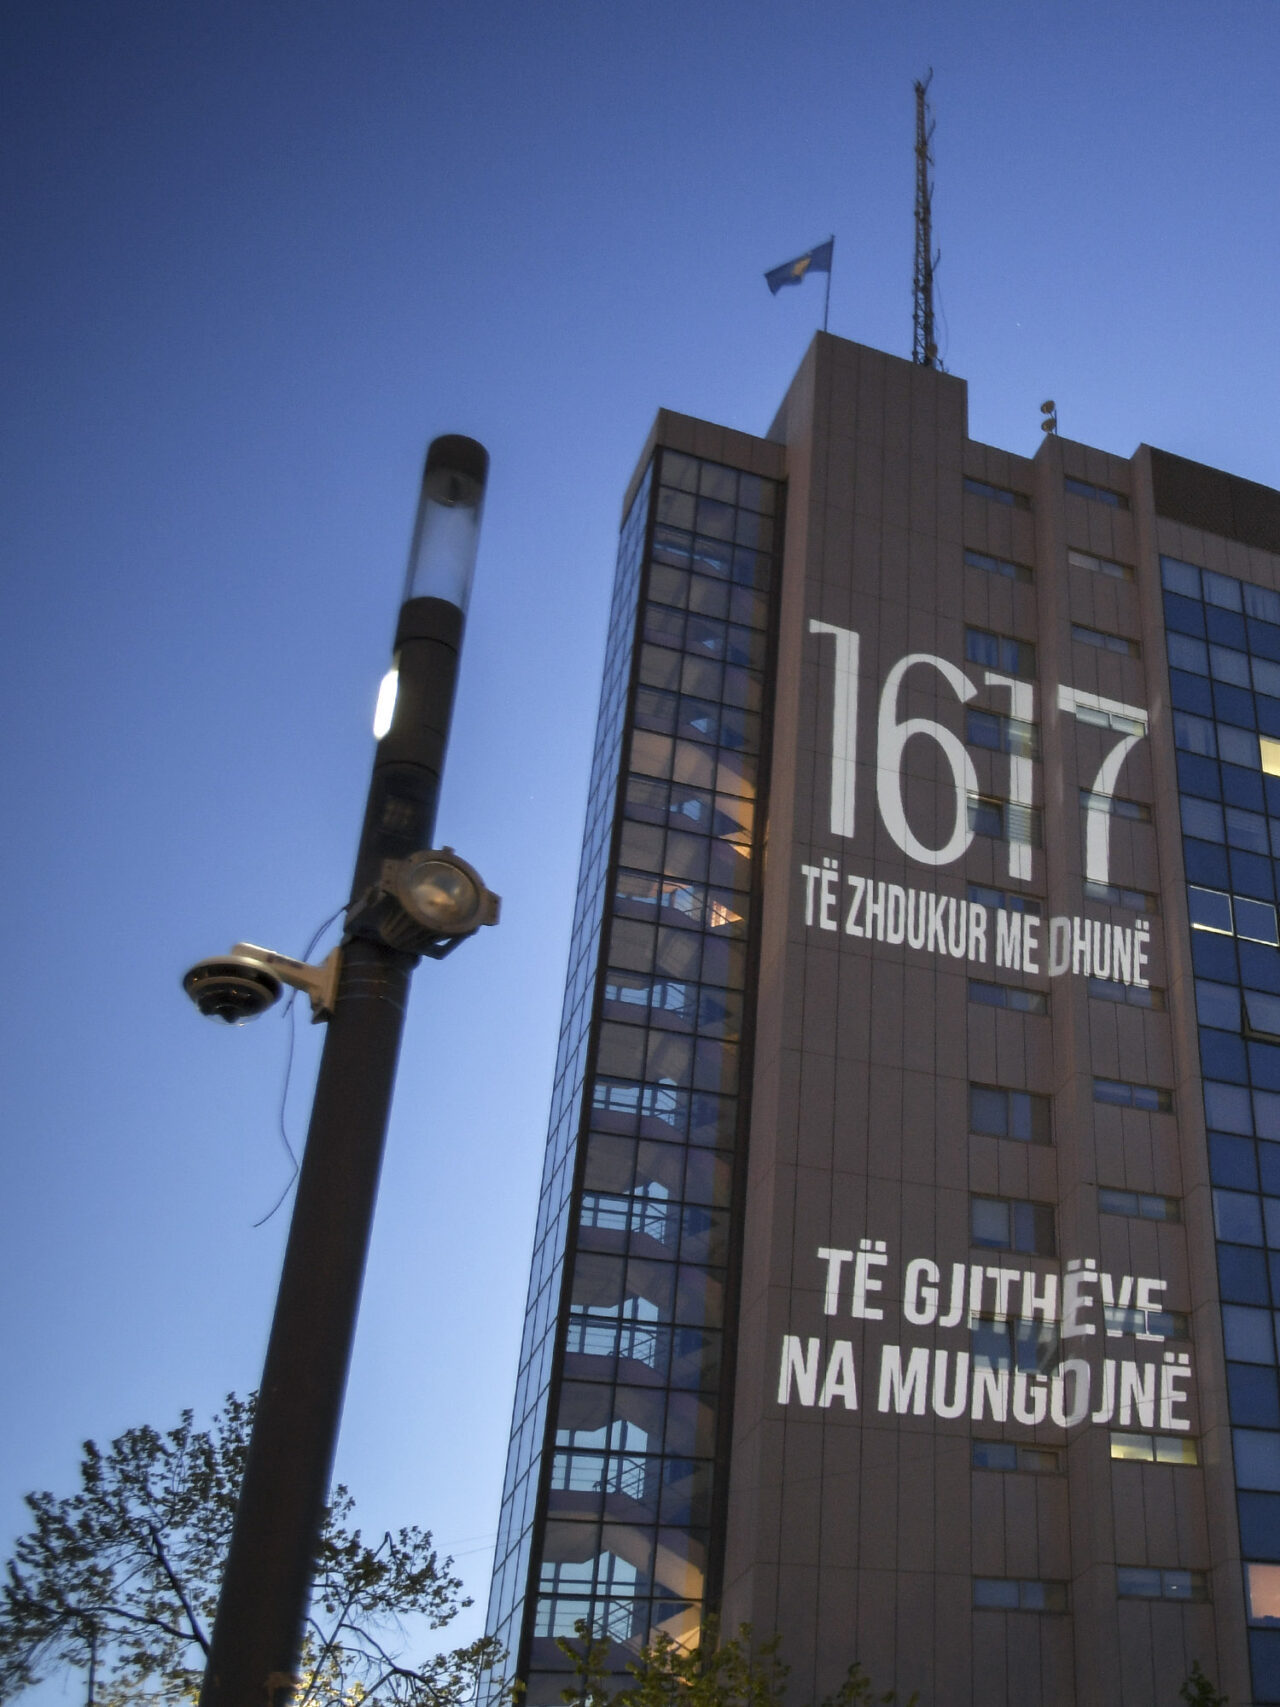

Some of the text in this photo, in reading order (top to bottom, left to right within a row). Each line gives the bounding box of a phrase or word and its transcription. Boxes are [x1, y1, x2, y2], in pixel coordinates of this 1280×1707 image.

[809, 619, 1149, 886] 1617
[802, 857, 1151, 988] TË ZHDUKUR ME DHUNË
[817, 1239, 1168, 1342] TË GJITHËVE
[777, 1335, 1192, 1431] NA MUNGOJNË
